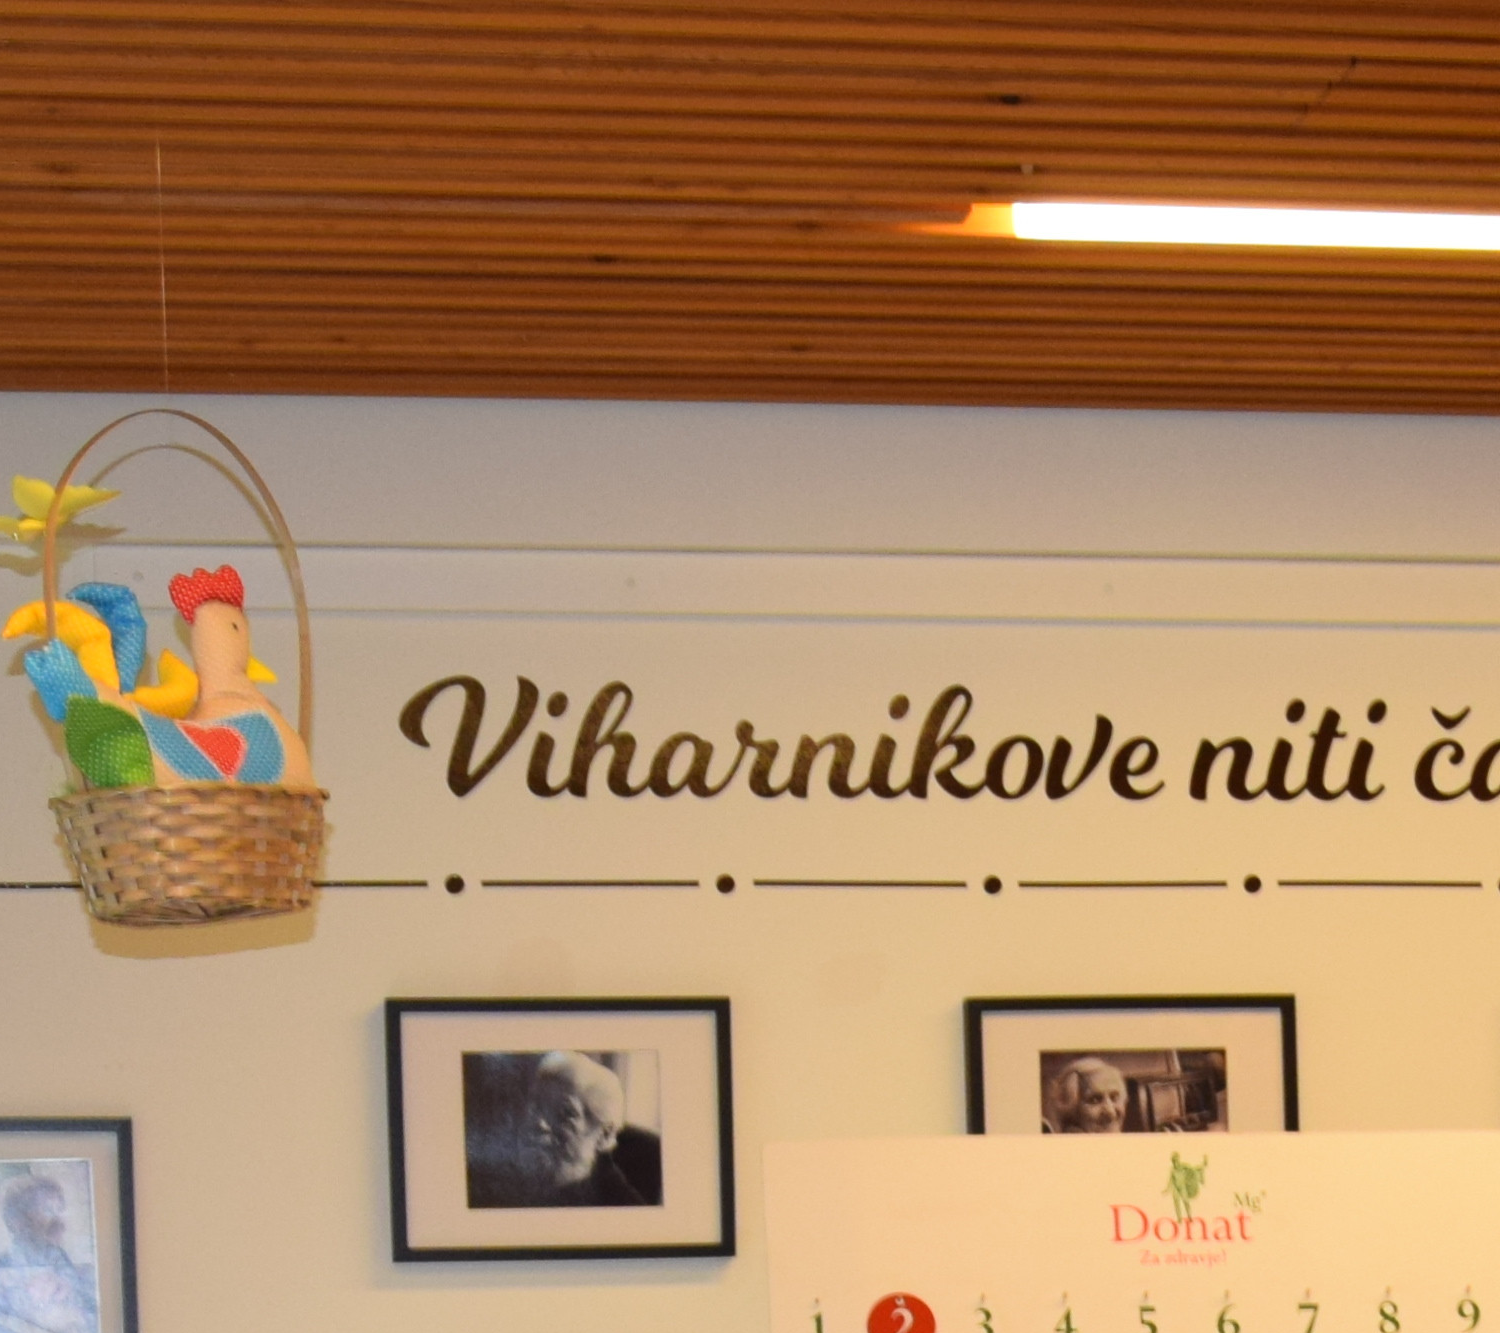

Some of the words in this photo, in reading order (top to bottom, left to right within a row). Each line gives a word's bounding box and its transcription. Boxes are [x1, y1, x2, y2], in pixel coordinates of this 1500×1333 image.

[400, 677, 1163, 800] Viharnikove
[1190, 701, 1386, 800] niti
[1109, 1204, 1254, 1243] Donat
[1458, 1300, 1480, 1333] 9
